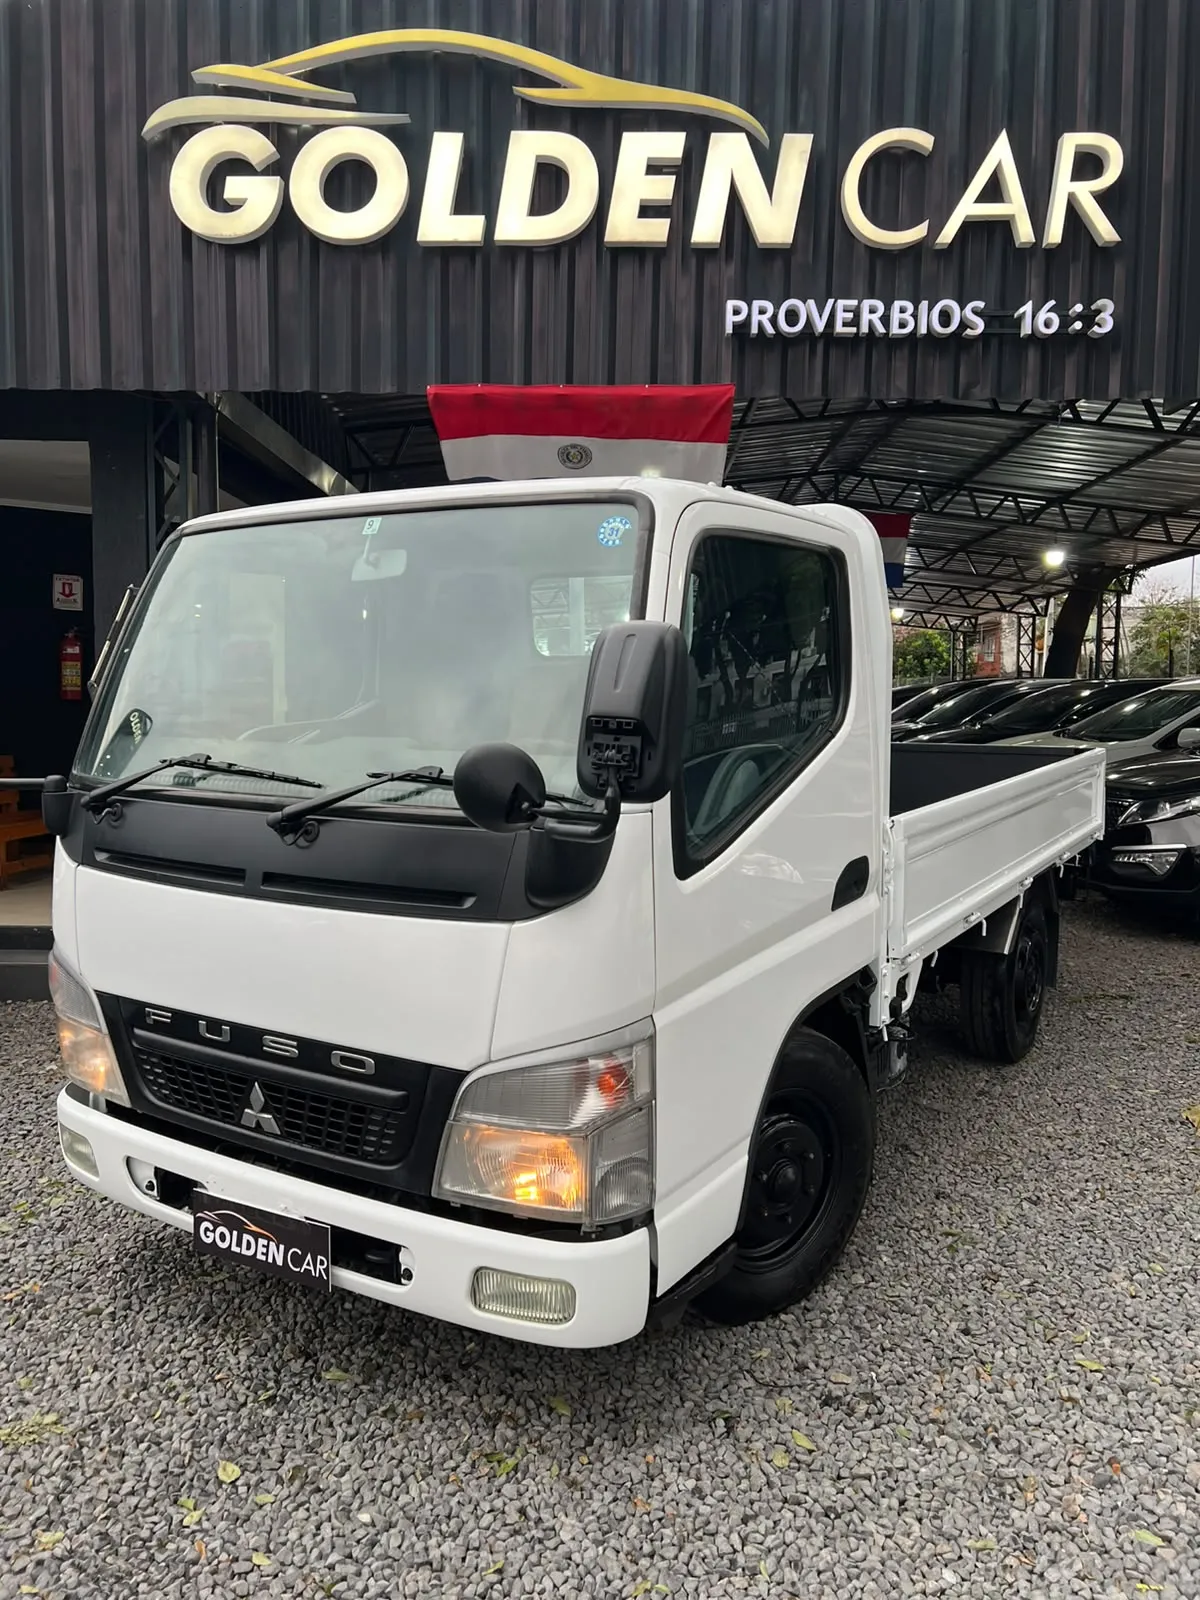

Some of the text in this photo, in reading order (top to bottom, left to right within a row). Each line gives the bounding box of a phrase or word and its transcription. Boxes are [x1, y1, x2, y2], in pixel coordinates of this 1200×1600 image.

[169, 125, 1124, 250] GOLDEN CAR
[725, 299, 985, 338] PROVERBIOS
[145, 1008, 376, 1075] FUSO
[200, 1221, 328, 1280] GOLDEN CAR
